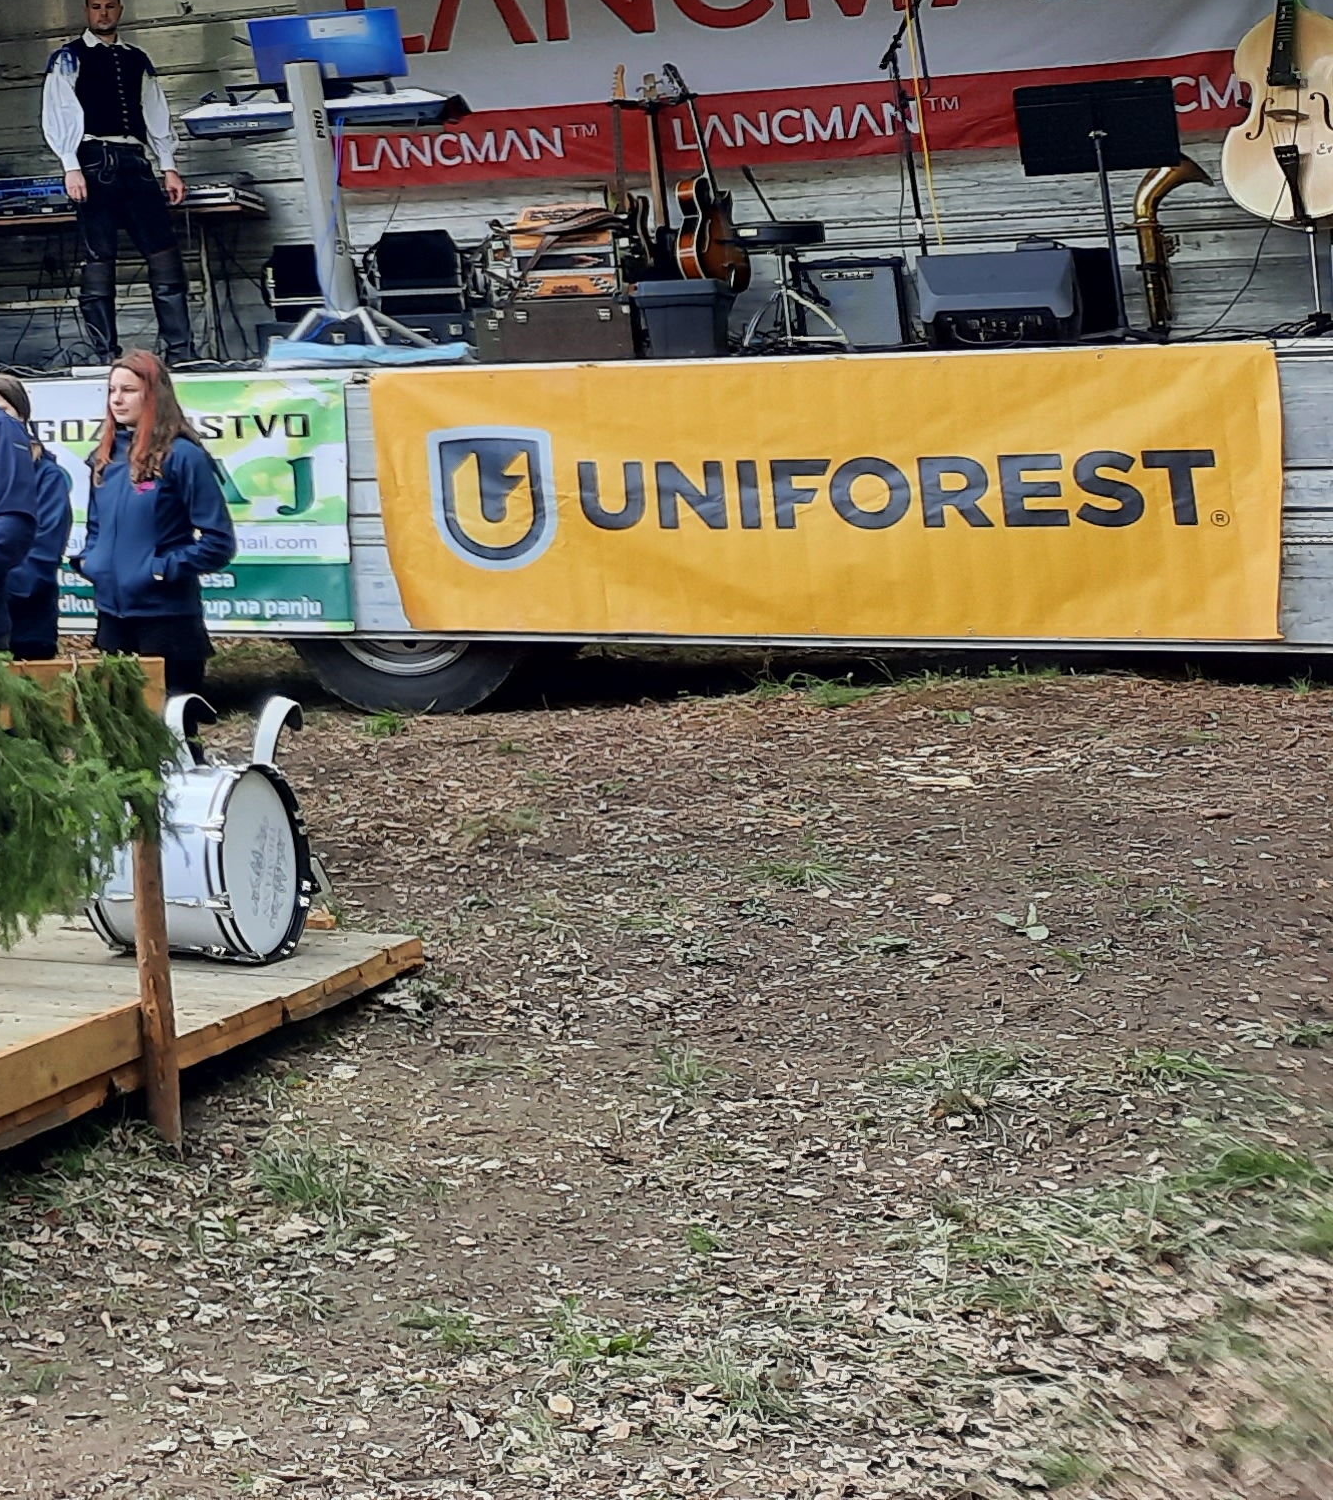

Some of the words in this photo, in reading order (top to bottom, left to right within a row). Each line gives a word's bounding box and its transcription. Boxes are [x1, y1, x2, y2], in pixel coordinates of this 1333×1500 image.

[348, 125, 564, 172] LANCMAN
[671, 99, 921, 151] LANCMAN
[577, 448, 1217, 531] UNIFOREST
[234, 600, 261, 615] na
[263, 595, 322, 619] panju
